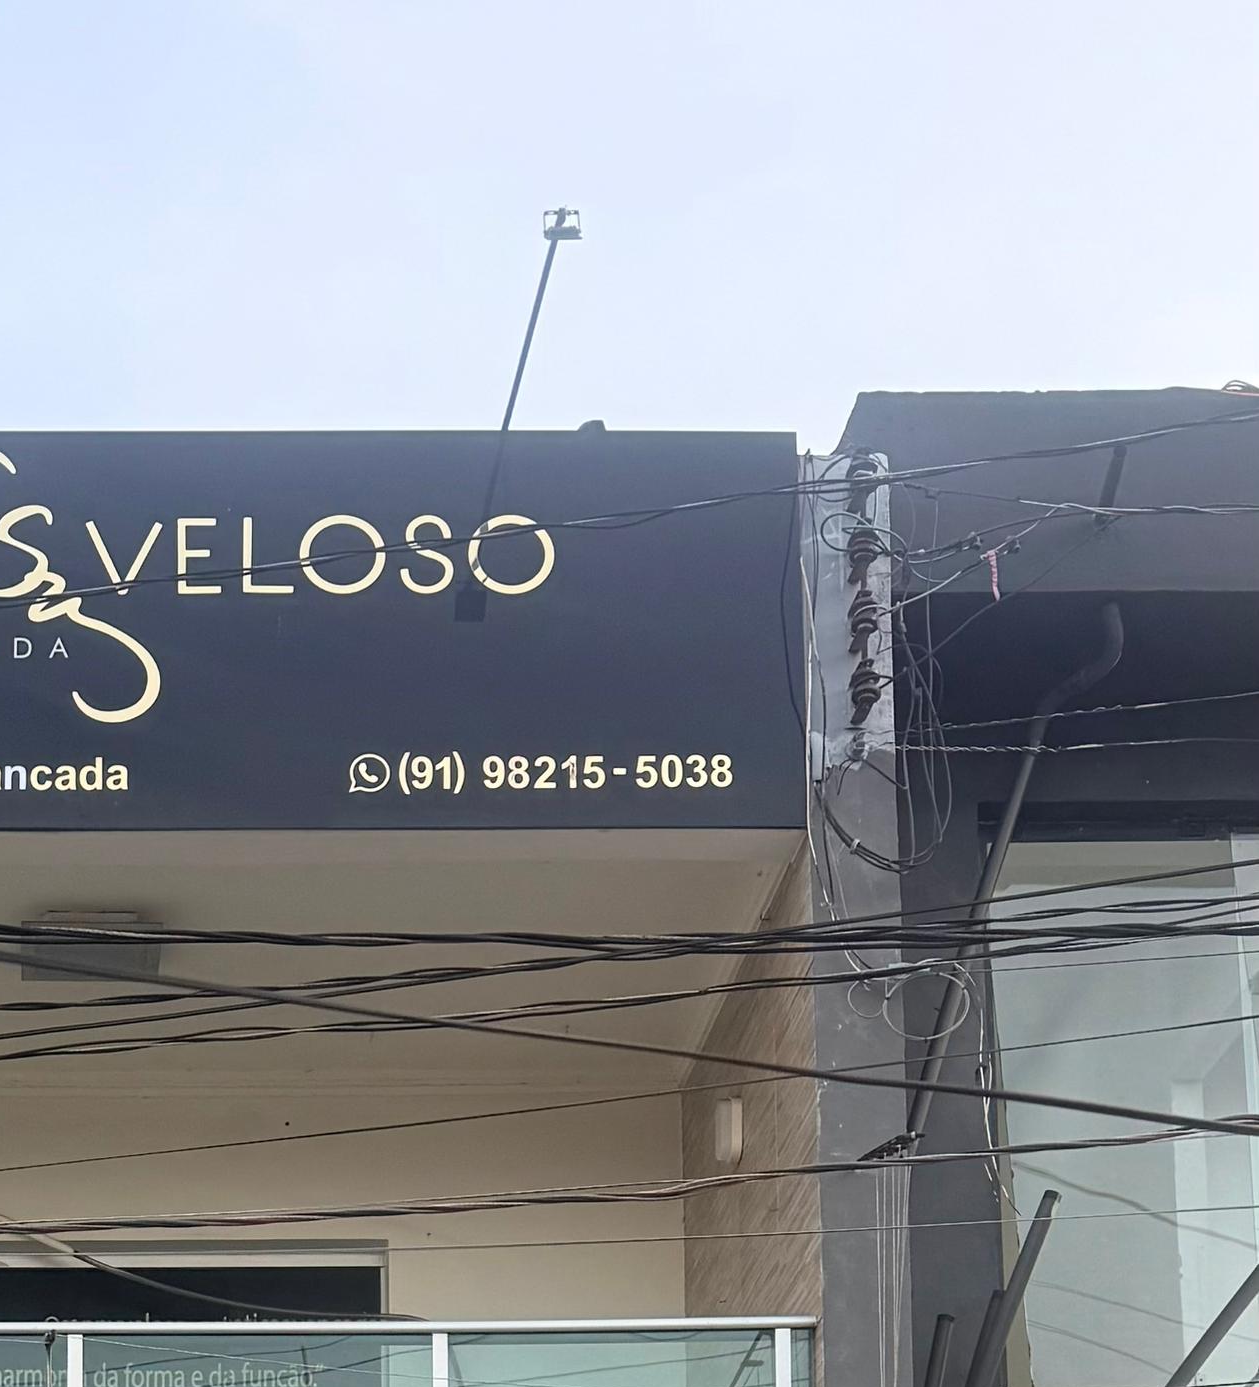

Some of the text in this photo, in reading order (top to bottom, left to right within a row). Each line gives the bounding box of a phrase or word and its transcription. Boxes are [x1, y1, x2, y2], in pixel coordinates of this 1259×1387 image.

[84, 514, 556, 597] VELOSO
[398, 751, 466, 795] (91)
[94, 1363, 119, 1387] da
[191, 1369, 203, 1387] e
